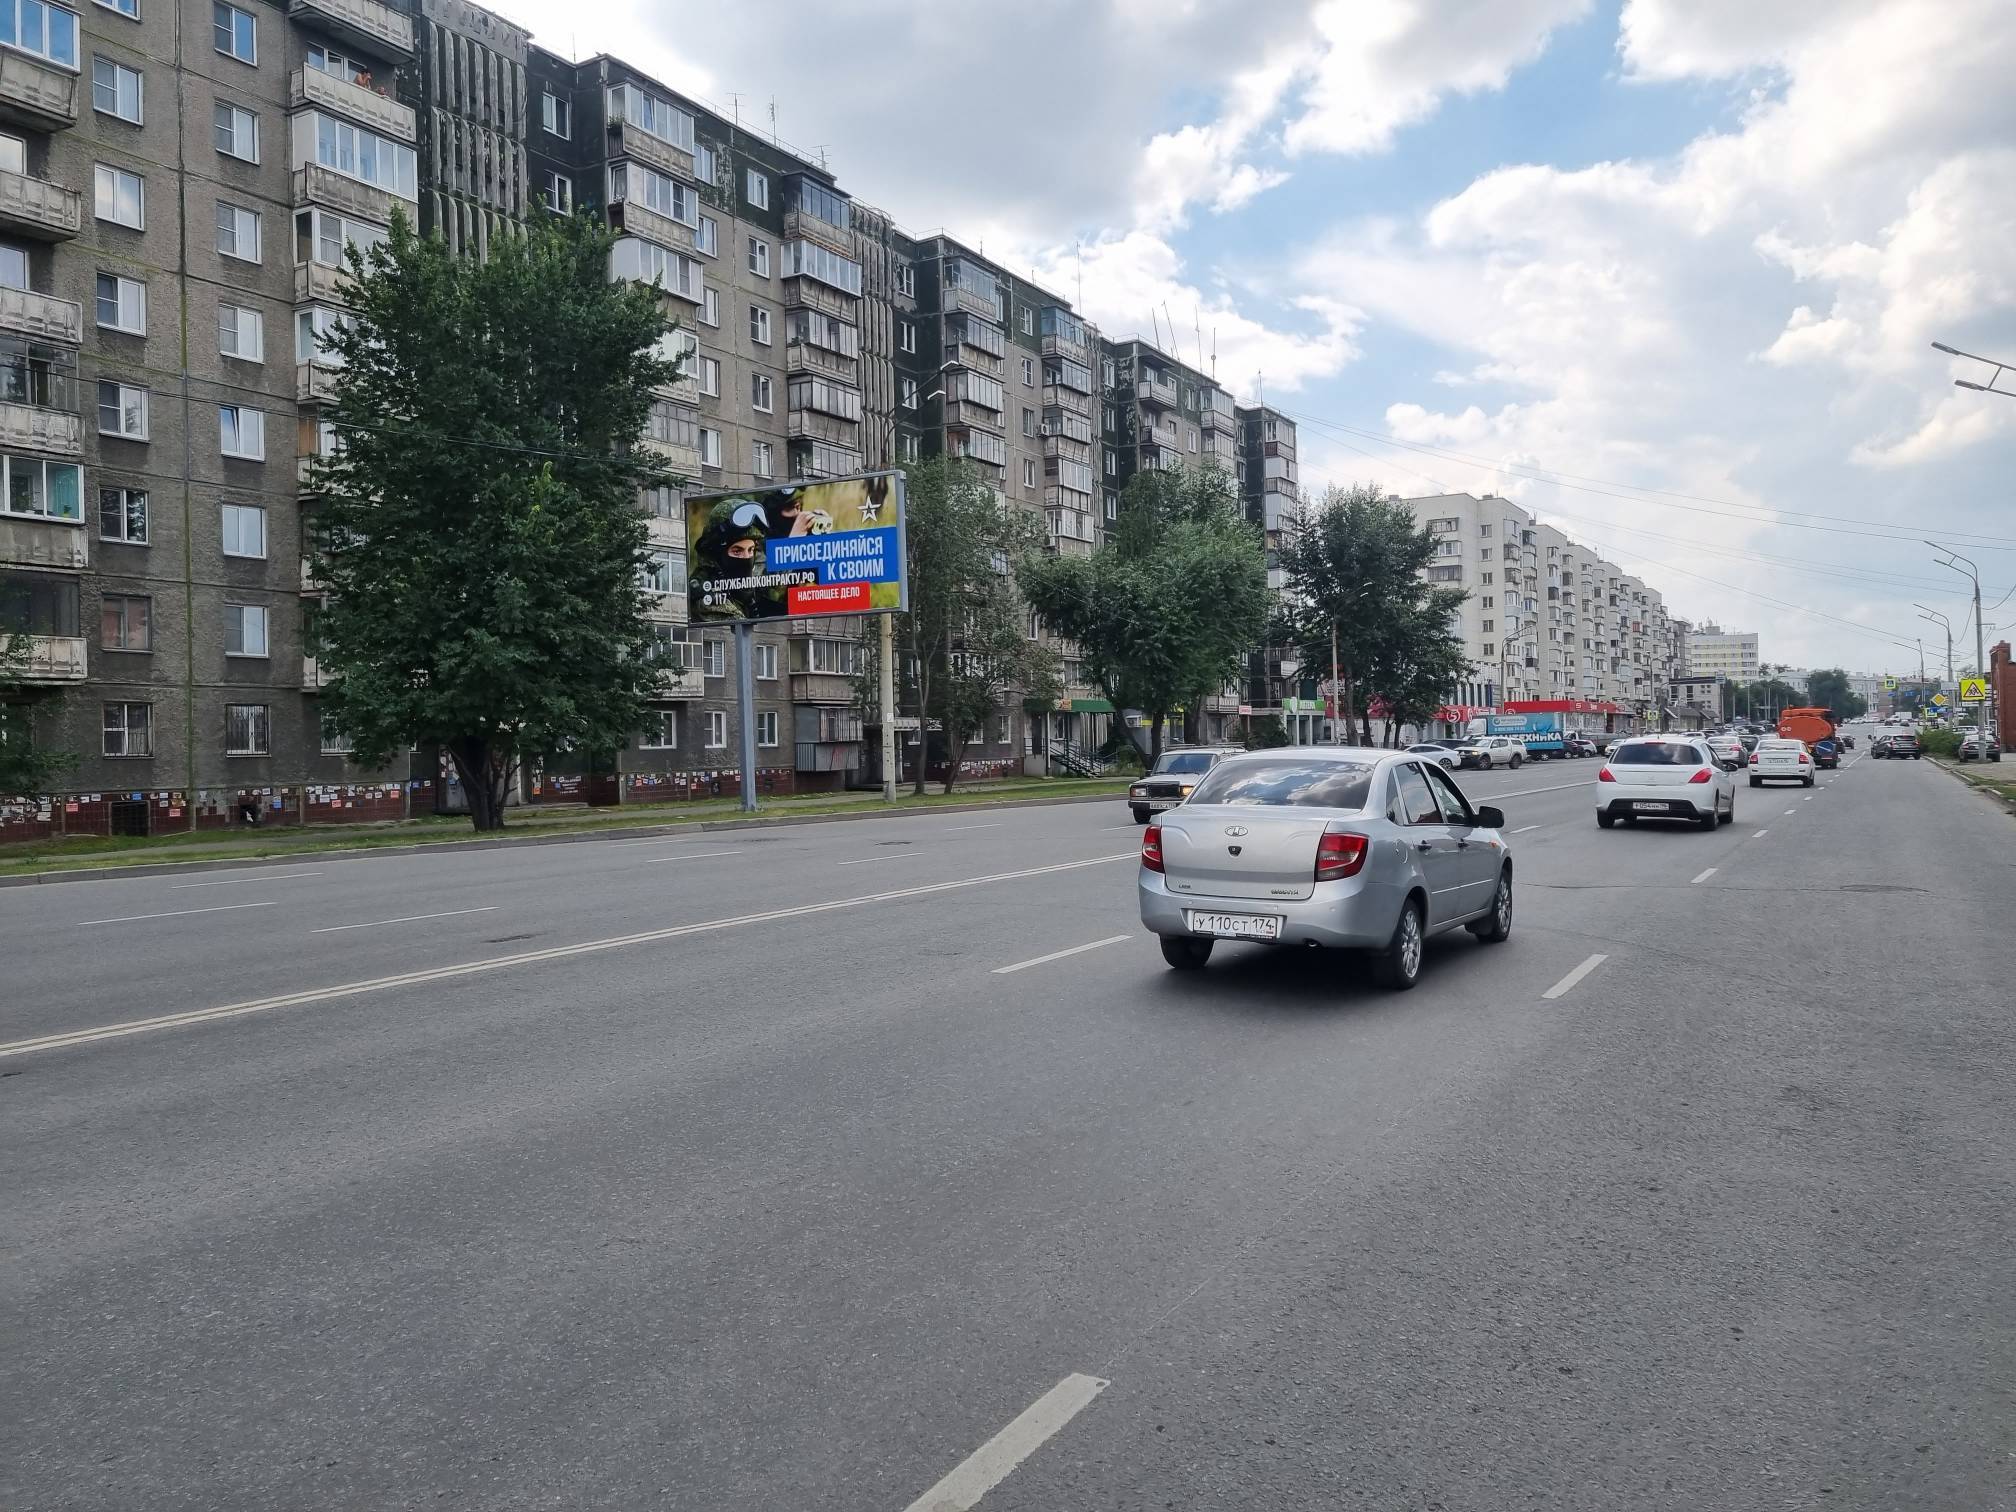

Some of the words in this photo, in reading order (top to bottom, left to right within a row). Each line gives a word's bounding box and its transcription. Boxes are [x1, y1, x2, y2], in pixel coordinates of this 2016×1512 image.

[774, 535, 883, 564] ПРИСОЕДИНЯЙСЯ
[827, 562, 837, 580] К
[838, 558, 884, 580] СВОИМ
[713, 571, 815, 591] СЛУЖБАПОКОНТРАКТУ.РФ
[714, 593, 727, 606] 117
[797, 588, 840, 602] НАСТОЯЩЕЕ
[840, 586, 861, 599] ДЕЛО
[1252, 918, 1272, 930] 174
